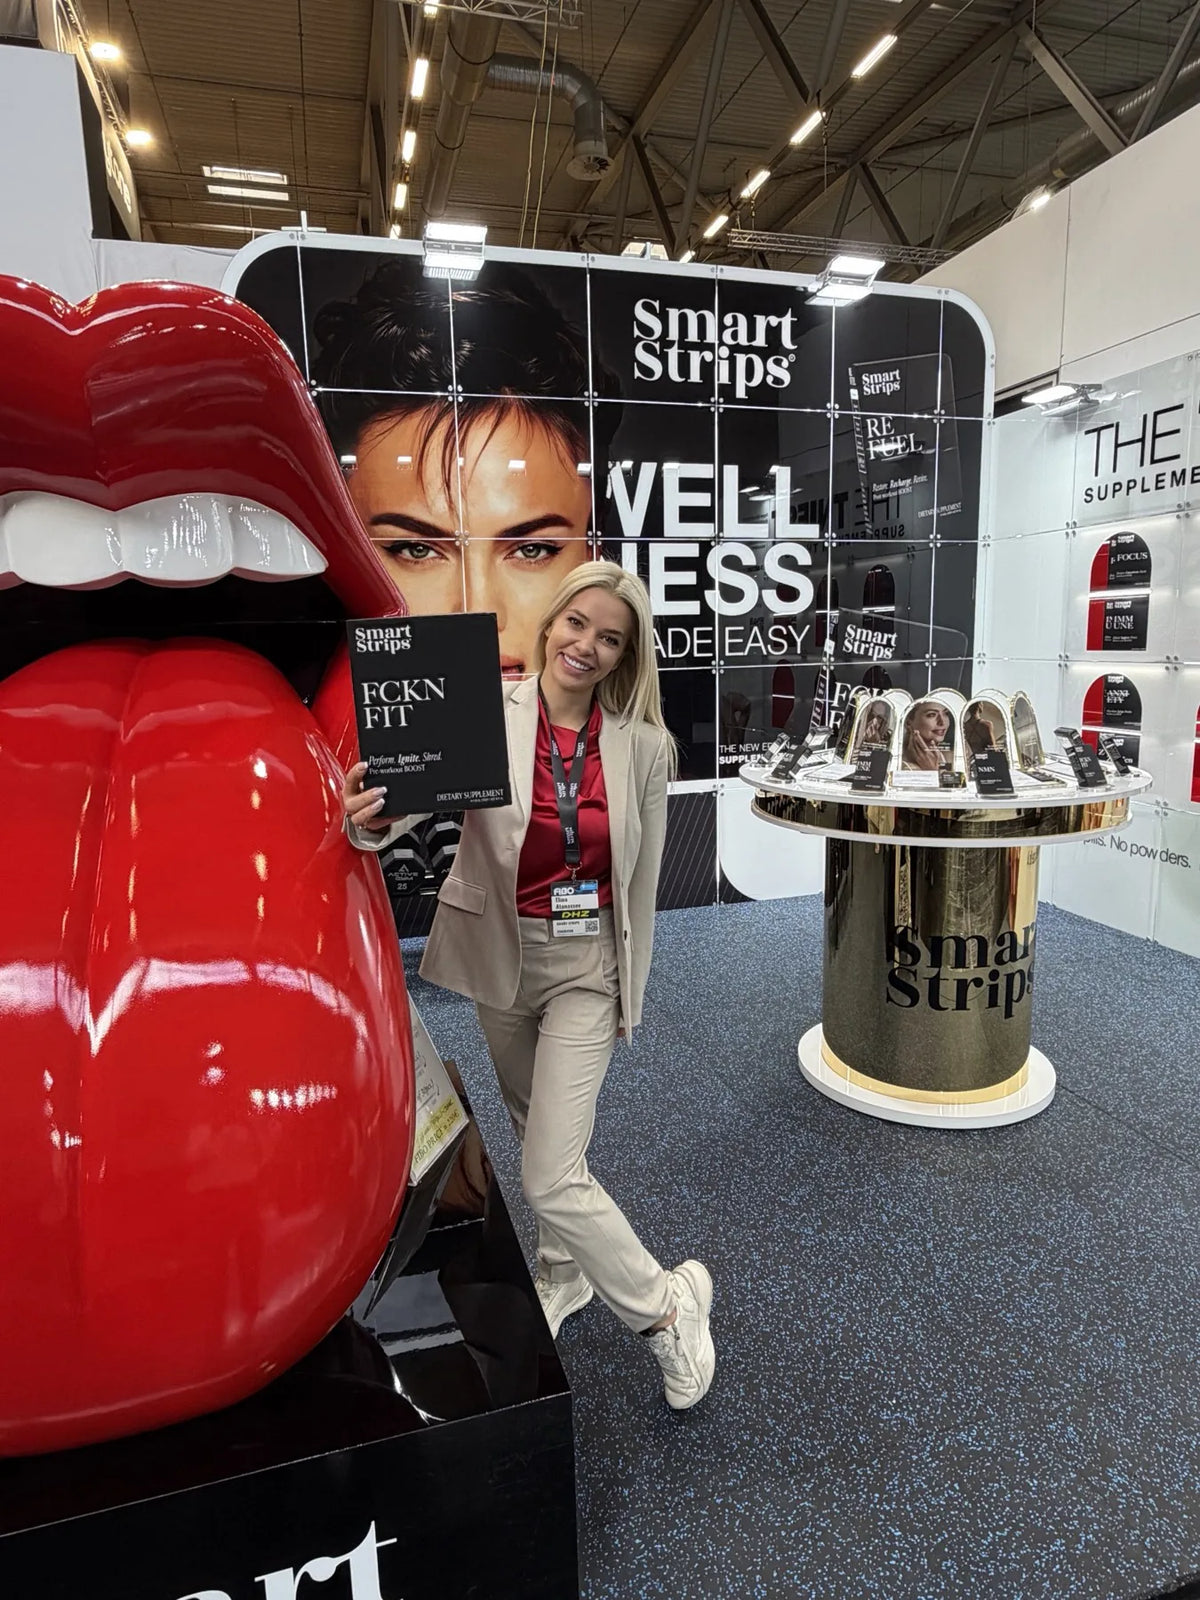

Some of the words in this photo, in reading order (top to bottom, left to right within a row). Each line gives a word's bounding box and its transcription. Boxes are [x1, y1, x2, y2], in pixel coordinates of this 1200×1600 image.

[633, 298, 798, 350] Smart
[862, 369, 901, 386] Smart
[863, 381, 900, 396] Strips
[866, 416, 895, 439] RE
[1084, 403, 1185, 477] THE
[1083, 466, 1200, 504] SUPPLEME
[1117, 552, 1148, 562] FOCUS
[621, 541, 814, 616] ESS
[355, 624, 412, 641] Smart
[652, 627, 713, 658] ADE
[725, 625, 811, 657] EASY
[845, 623, 898, 647] Smart
[356, 636, 412, 655] Strips
[842, 636, 895, 661] Strips
[361, 677, 446, 705] FCKN
[363, 704, 414, 729] FIT
[719, 744, 737, 754] THE
[739, 742, 760, 752] NEW
[368, 754, 397, 768] Perform.
[398, 752, 421, 766] Ignite.
[422, 751, 443, 762] Shred.
[404, 764, 426, 773] BOOST
[718, 754, 763, 765] SUPPLE
[436, 793, 463, 802] DIETARY
[463, 788, 504, 799] SUPPLEMENT
[1110, 835, 1128, 852] No
[561, 910, 590, 919] DHZ
[886, 921, 1035, 969] Smar
